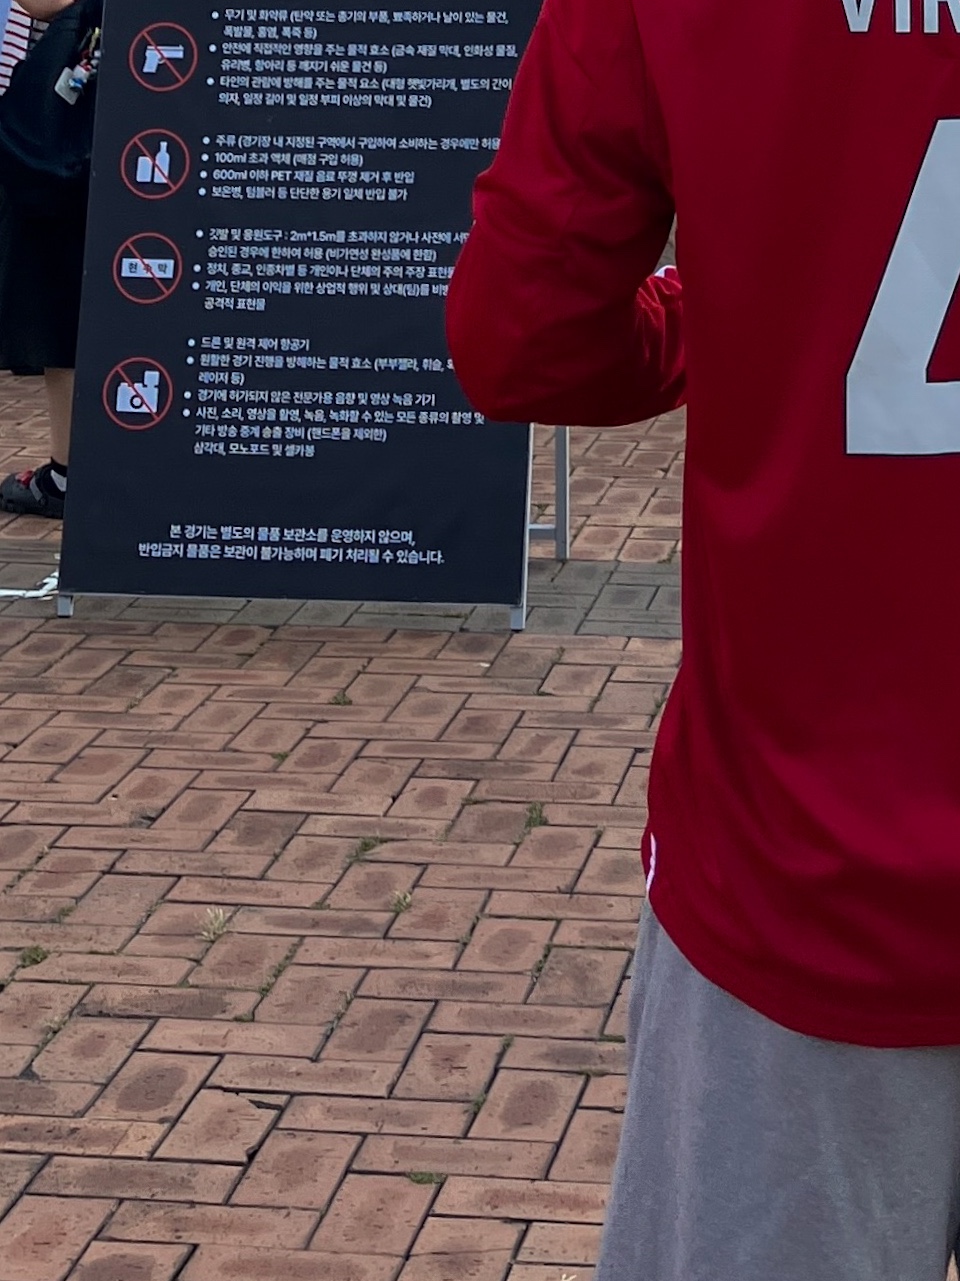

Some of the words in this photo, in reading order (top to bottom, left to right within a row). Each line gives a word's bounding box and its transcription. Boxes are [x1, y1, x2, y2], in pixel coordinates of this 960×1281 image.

[214, 152, 247, 163] 100ml
[213, 169, 248, 180] 600ml
[170, 525, 181, 538] 본
[184, 524, 218, 539] 경기는
[220, 526, 255, 540] 별도의
[257, 527, 281, 541] 물품
[282, 528, 328, 542] 보관소를
[331, 529, 376, 543] 운영하지
[378, 530, 416, 546] 않으며,
[138, 543, 184, 557] 반입금지
[186, 544, 222, 558] 물품은
[224, 545, 258, 559] 보관이
[261, 546, 317, 561] 불가능하며
[319, 548, 343, 562] 폐기
[345, 548, 379, 563] 처리될
[382, 550, 394, 563] 수
[396, 550, 445, 564] 있습니다.
